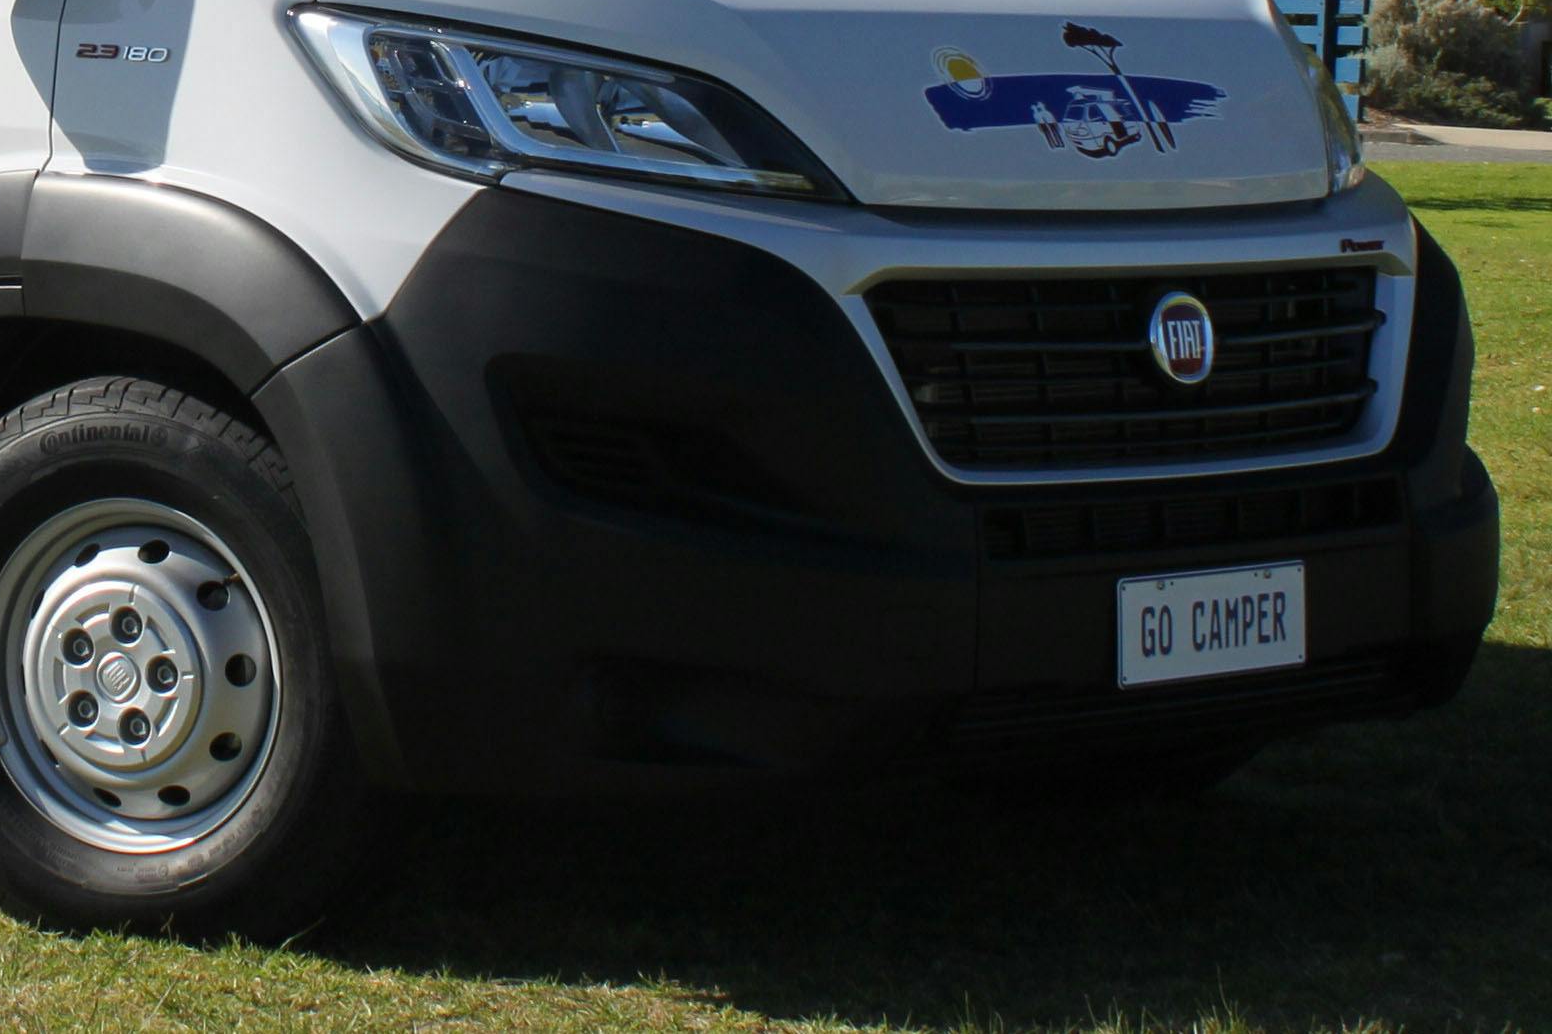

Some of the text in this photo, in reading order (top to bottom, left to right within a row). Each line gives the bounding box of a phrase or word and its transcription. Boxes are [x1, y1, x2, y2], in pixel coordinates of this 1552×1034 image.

[1167, 320, 1201, 359] FIAT
[1141, 591, 1286, 658] GO CAMPER
